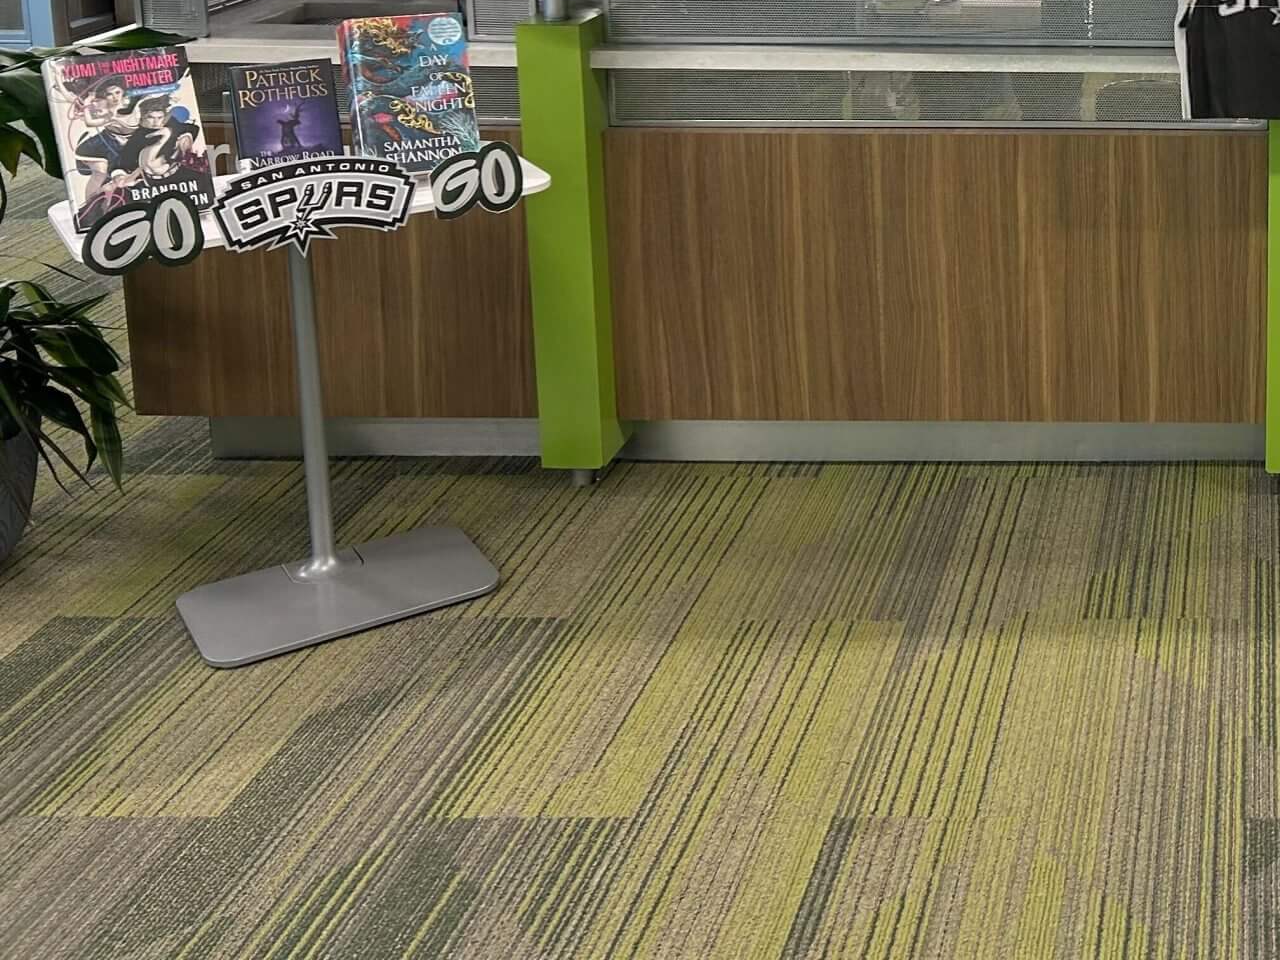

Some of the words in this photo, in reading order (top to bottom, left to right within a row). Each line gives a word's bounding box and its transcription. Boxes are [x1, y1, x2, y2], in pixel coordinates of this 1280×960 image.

[62, 62, 97, 80] YUMI
[112, 54, 180, 74] NIGHTMARE
[418, 54, 449, 67] DAY
[124, 70, 174, 88] PAINTER
[245, 68, 323, 89] PATRICK
[429, 72, 445, 82] OF
[238, 83, 329, 109] ROTHFUSS
[415, 98, 465, 113] NIGHT
[384, 135, 461, 152] SAMANTHA
[250, 152, 301, 168] NARROW
[302, 149, 335, 161] ROAD
[386, 147, 462, 164] SHANNON
[240, 171, 284, 190] SAN
[295, 162, 390, 177] ANTONIO
[432, 144, 520, 214] GO
[234, 181, 398, 232] SPURS
[88, 196, 199, 271] GO
